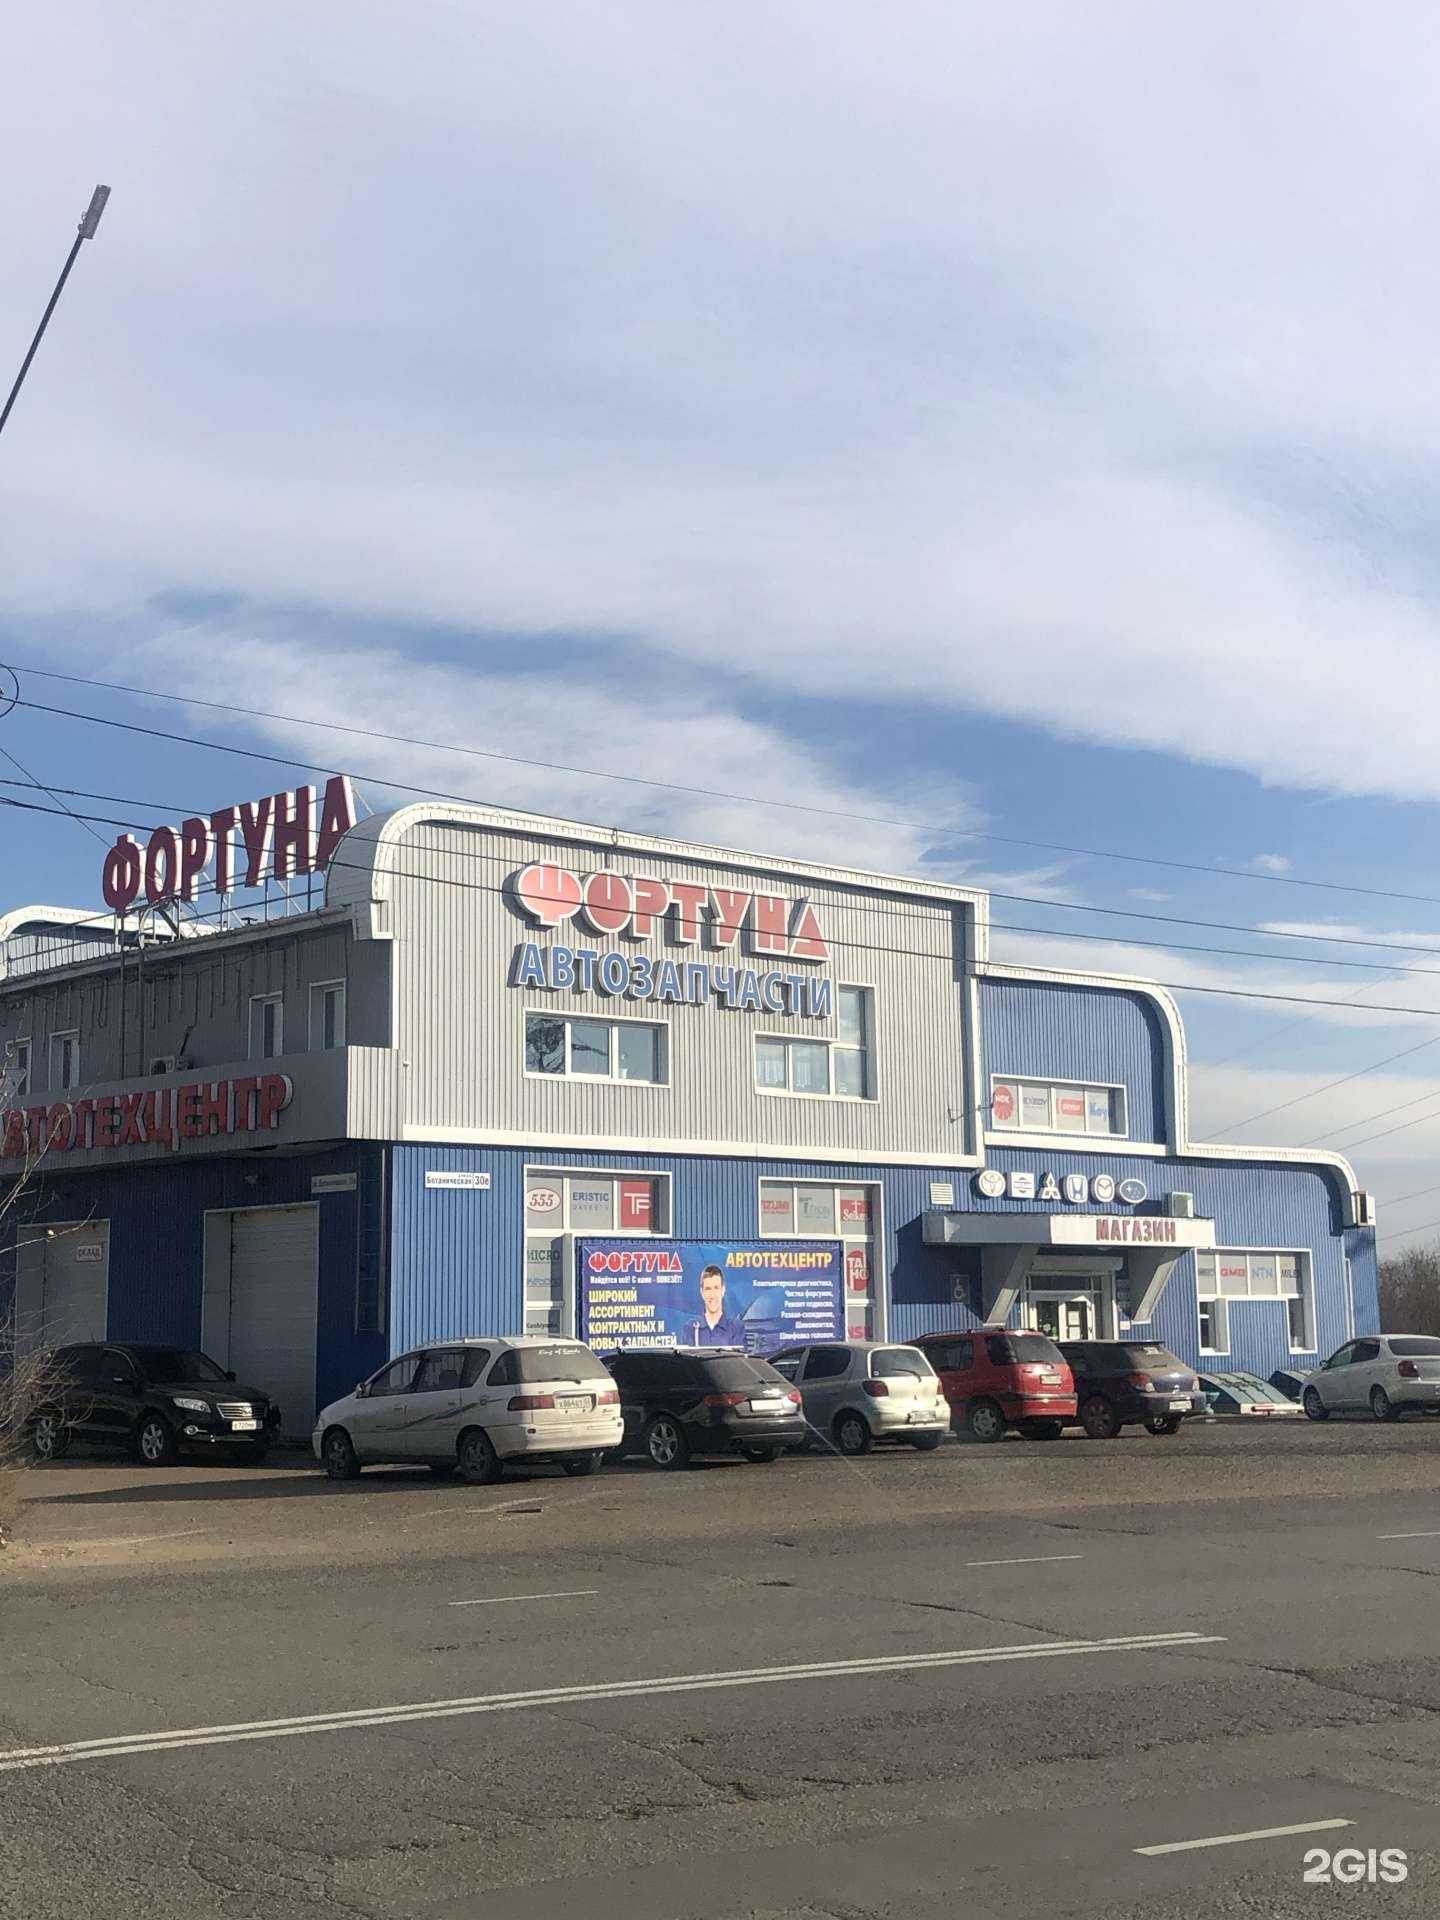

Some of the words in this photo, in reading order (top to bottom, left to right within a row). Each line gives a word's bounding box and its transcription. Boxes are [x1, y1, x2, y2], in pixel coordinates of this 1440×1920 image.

[102, 775, 357, 918] ФОРТУНА
[514, 859, 831, 962] ФОРТУНА
[516, 942, 833, 1018] АВТОЗАПЧАСТИ
[0, 1073, 293, 1158] ВТОТЕХЦЕНТР
[529, 1193, 554, 1208] 555
[572, 1191, 610, 1202] ERISTIC
[1095, 1218, 1177, 1244] МАГАЗИН
[588, 1251, 684, 1272] ФОРТУНА
[724, 1251, 833, 1271] АВТОТЕХЦЕНТР
[588, 1286, 638, 1303] ШИРОКИЙ
[588, 1305, 656, 1319] АССОРТИМЕНТ
[588, 1321, 657, 1335] КОНТРАКТНЫХ
[657, 1320, 665, 1333] И
[588, 1337, 623, 1350] НОВЫХ
[624, 1332, 677, 1348] ЗАПЧАСТЕЙ
